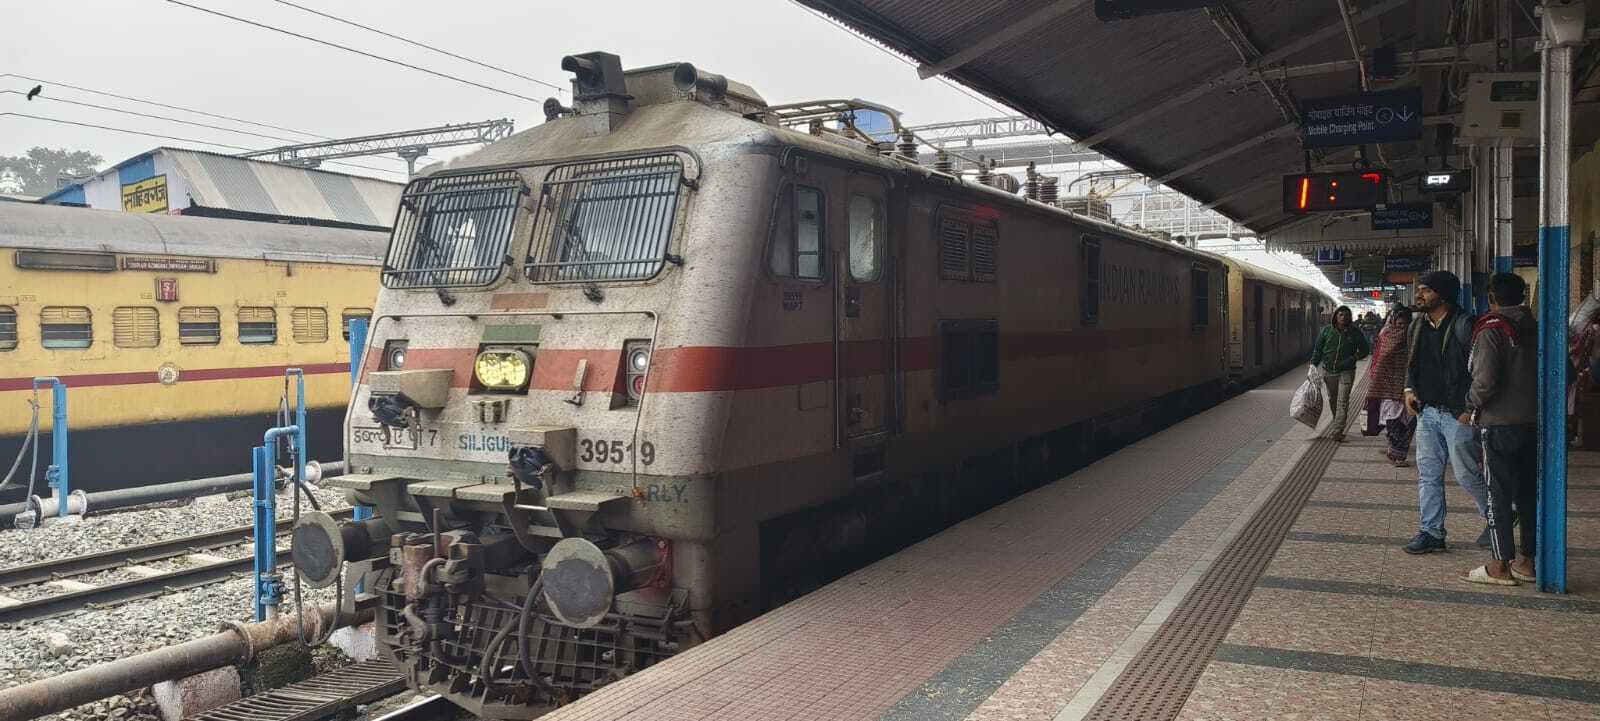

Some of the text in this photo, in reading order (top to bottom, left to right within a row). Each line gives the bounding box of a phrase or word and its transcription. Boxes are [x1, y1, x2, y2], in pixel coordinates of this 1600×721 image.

[1308, 119, 1375, 136] Mobile Charging Point
[428, 430, 438, 446] 7
[580, 438, 656, 466] 39519
